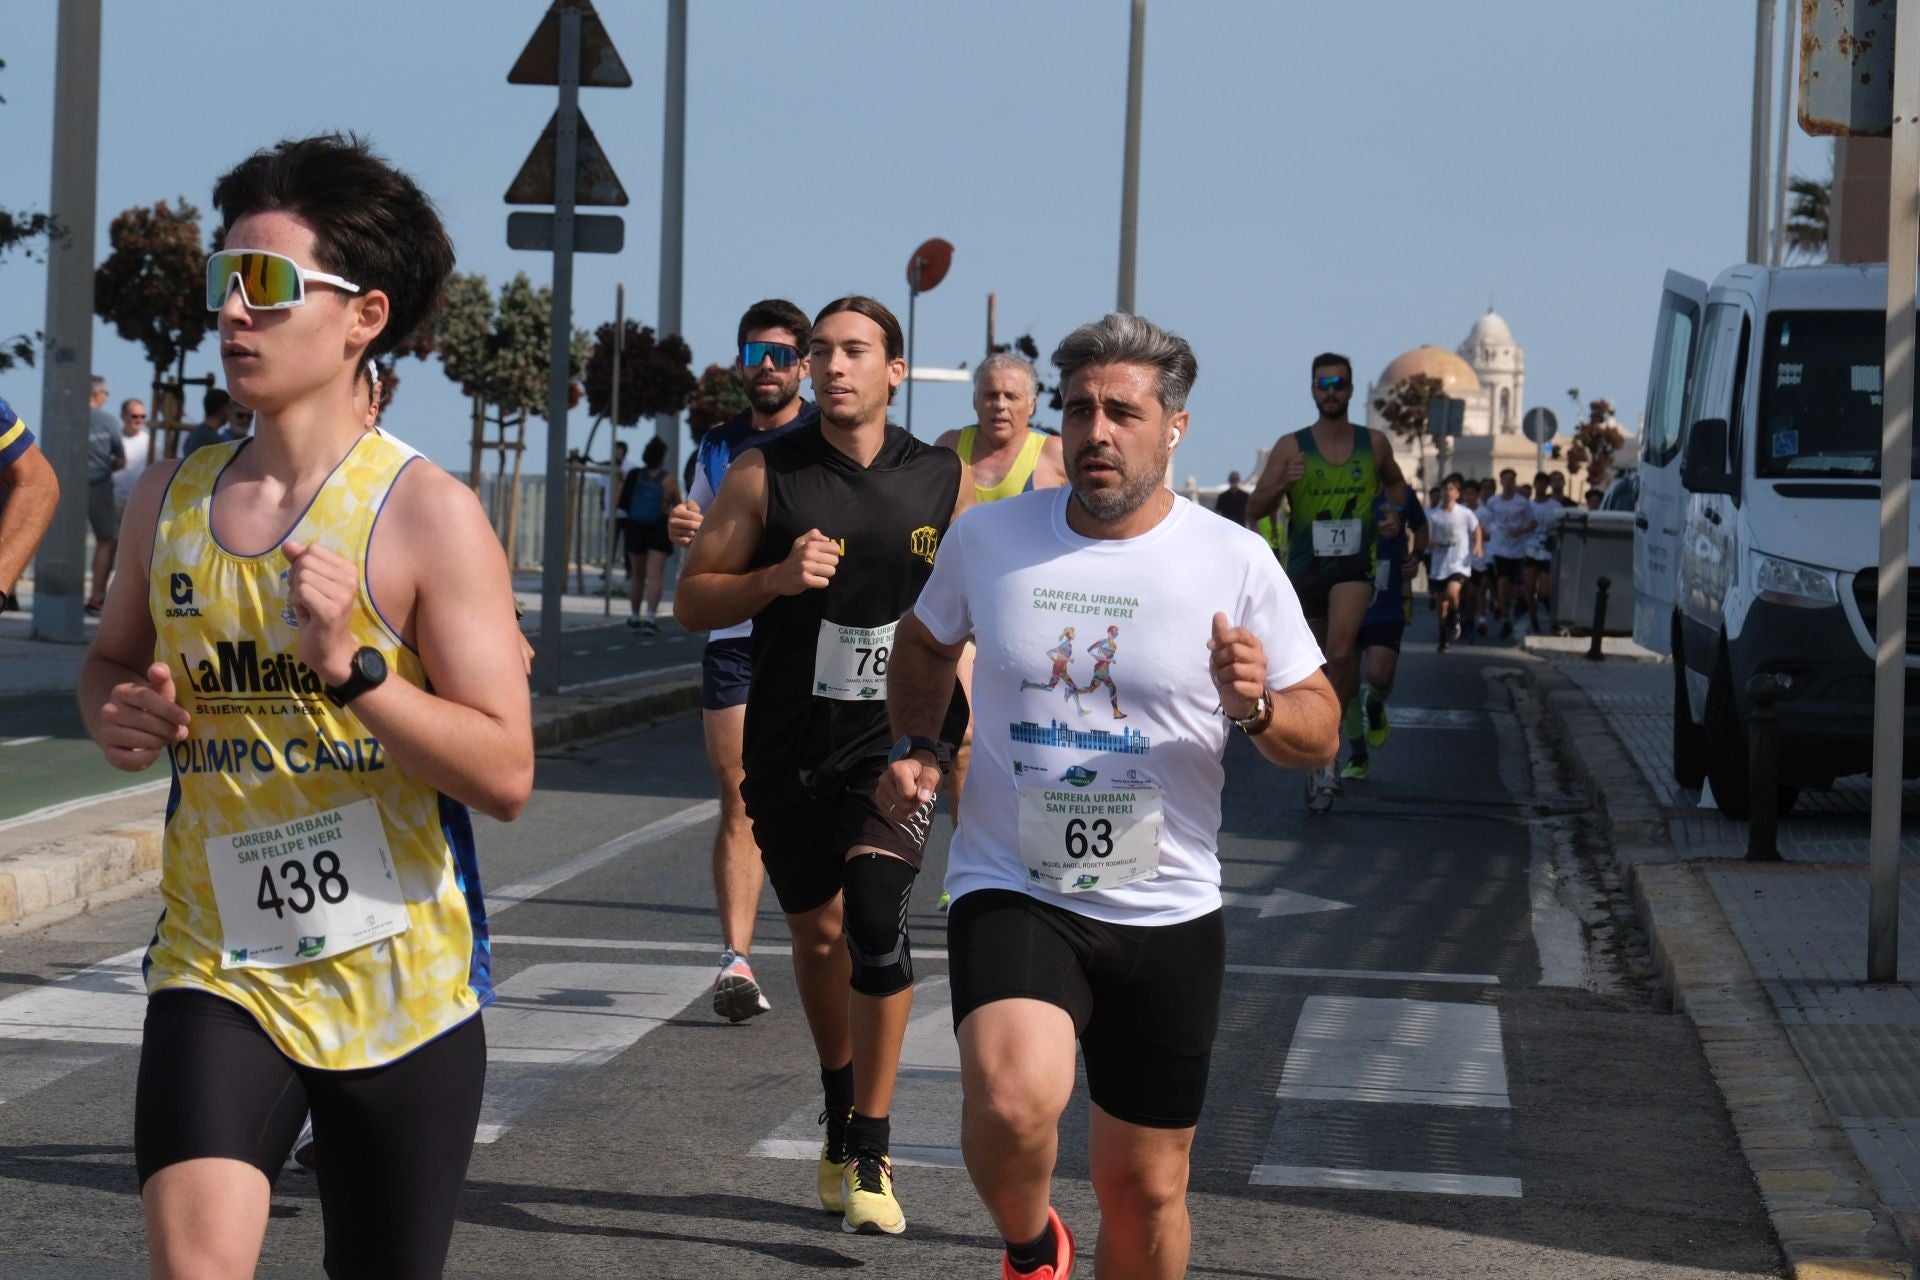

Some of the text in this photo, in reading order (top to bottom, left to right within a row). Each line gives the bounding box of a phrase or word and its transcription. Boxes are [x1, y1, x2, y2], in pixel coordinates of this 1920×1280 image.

[1331, 529, 1346, 544] 71
[1033, 587, 1139, 607] CARRERA URBANA
[1032, 600, 1134, 619] SAN FELIPE NERI
[838, 627, 876, 637] CARRERA
[840, 636, 856, 645] SAN
[858, 636, 884, 645] FELIPE
[855, 646, 889, 676] 78
[257, 705, 267, 715] A
[271, 705, 289, 715] LA
[293, 704, 326, 716] MESA
[174, 727, 385, 774] OLIMPO CÁDIZ
[1043, 791, 1137, 803] CARRERA URBANA
[1045, 803, 1133, 815] SAN FELIPE NERI
[232, 811, 343, 849] CARRERA URBANA
[1065, 818, 1114, 859] 63
[237, 827, 343, 864] SAN FELIPE NERI
[257, 850, 349, 919] 438
